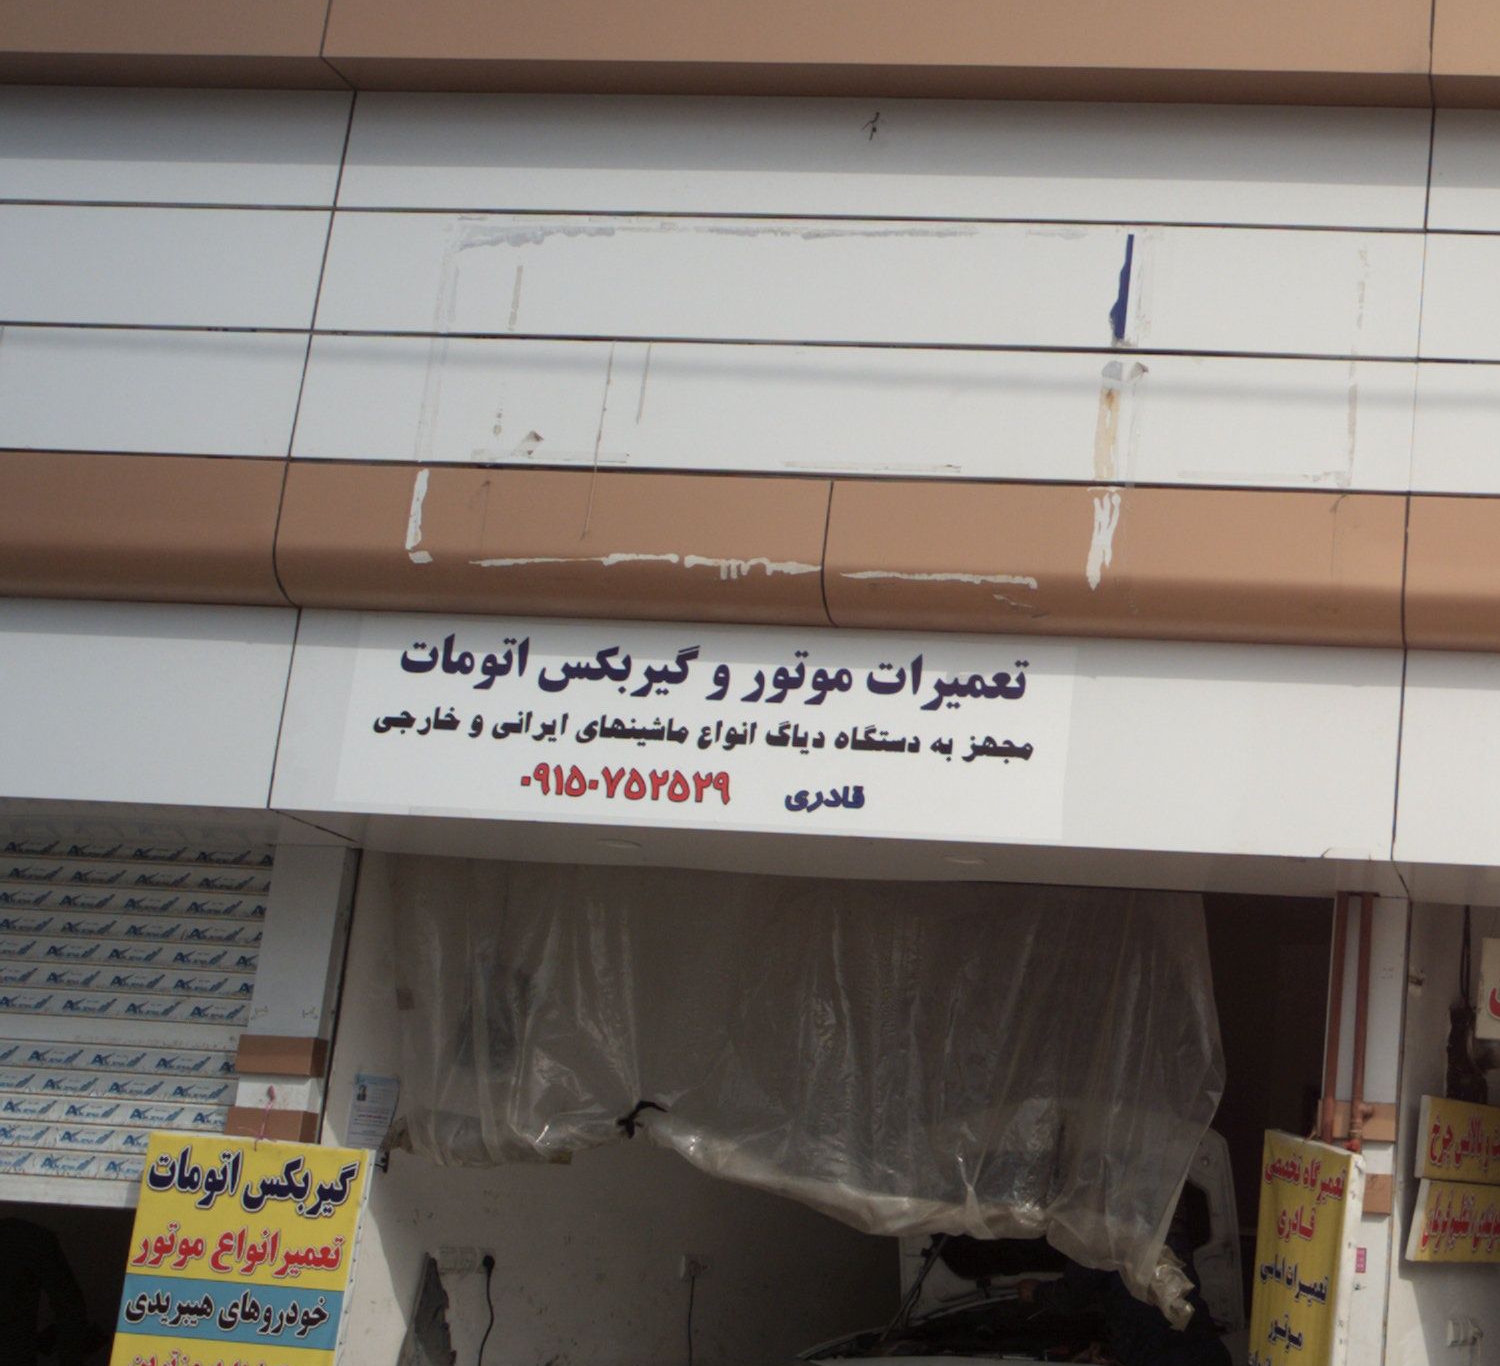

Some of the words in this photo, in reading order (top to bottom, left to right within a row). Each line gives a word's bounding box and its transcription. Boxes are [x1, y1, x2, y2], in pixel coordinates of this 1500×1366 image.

[401, 632, 531, 690] اتومات
[538, 645, 702, 697] گیربکس
[741, 650, 853, 705] موتور
[705, 664, 731, 701] و
[867, 653, 1029, 711] تعمیرات
[373, 706, 461, 736] خارجی
[468, 714, 484, 739] و
[492, 711, 569, 743] ایرانی
[576, 715, 689, 747] ماشینهای
[698, 720, 758, 751] انواع
[766, 721, 826, 755] دیاگ
[834, 724, 921, 754] دستگاه
[930, 737, 953, 762] به
[962, 735, 1034, 764] مجهز
[520, 762, 731, 806] ۰۹۱۵۰۷۵۲۵۲۹
[784, 785, 865, 813] قادری
[148, 1147, 241, 1207] اتومات
[242, 1155, 358, 1216] گیربکس
[1264, 1152, 1302, 1185] تخصصی
[1276, 1205, 1316, 1242] قادری
[132, 1222, 205, 1268] موتور
[211, 1226, 278, 1273] انواع
[273, 1235, 344, 1276] تعمیر
[1259, 1253, 1286, 1285] اساسی
[1285, 1263, 1328, 1306] تعمیرات
[125, 1289, 214, 1327] هیبریدی
[217, 1290, 328, 1337] خودروهای
[1267, 1313, 1303, 1353] موتور
